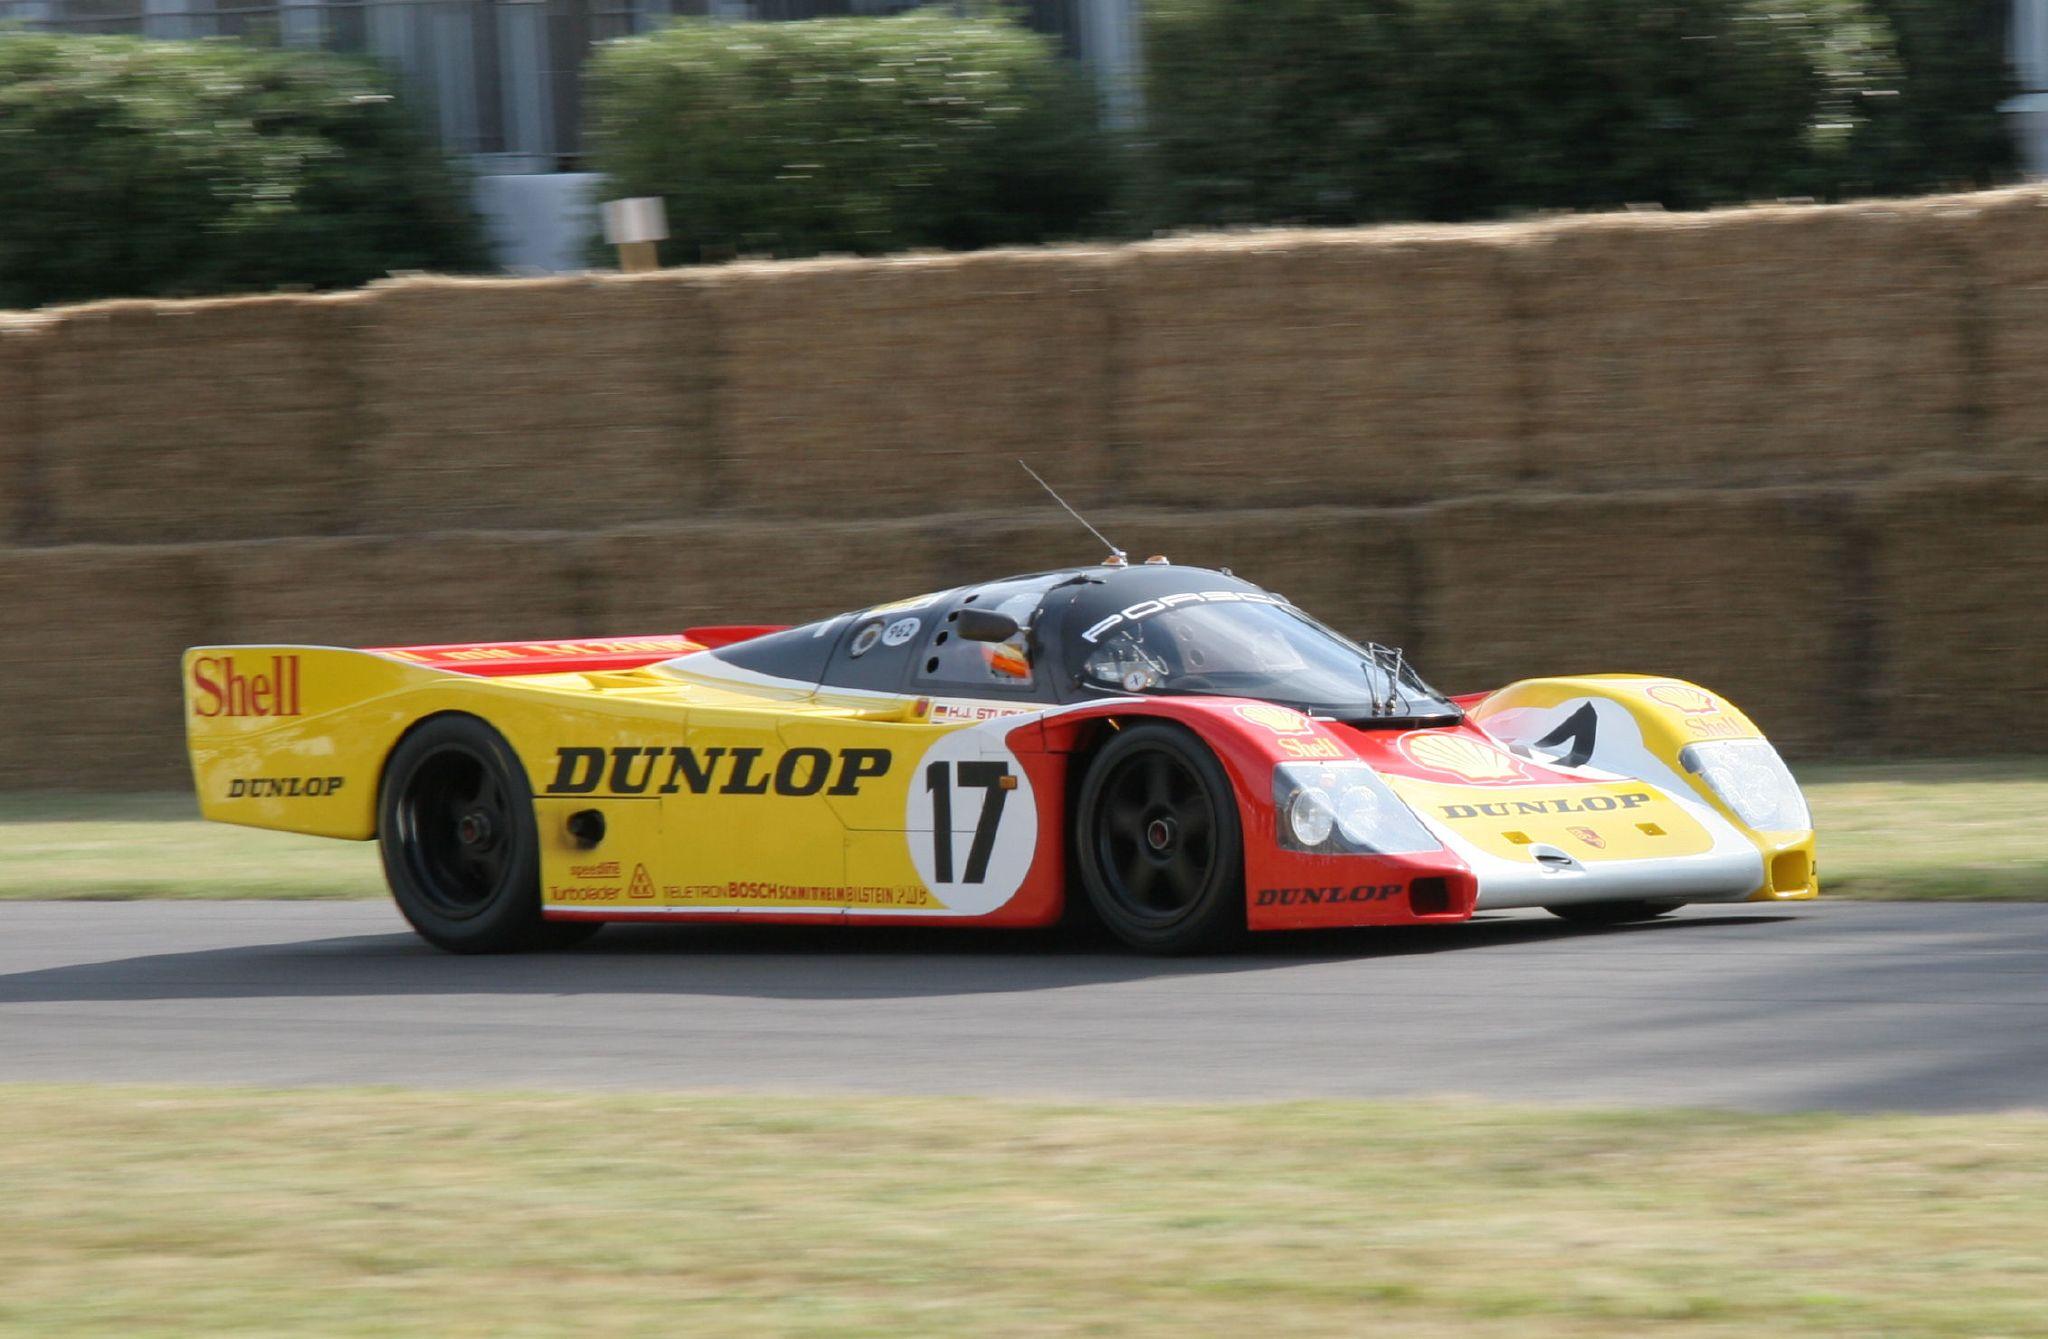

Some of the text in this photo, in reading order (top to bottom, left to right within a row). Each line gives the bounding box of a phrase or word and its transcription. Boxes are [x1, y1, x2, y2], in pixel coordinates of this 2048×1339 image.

[1082, 591, 1290, 643] PORSC
[889, 623, 915, 639] 962
[193, 655, 301, 717] Shell
[1684, 717, 1743, 738] Shell
[1277, 738, 1344, 757] Shell
[546, 746, 892, 796] DUNLOP
[227, 776, 344, 799] DUNLOP
[1438, 793, 1651, 819] DUNLOP
[926, 760, 1010, 884] 17
[728, 881, 777, 899] BOSCH
[847, 886, 893, 904] BILSTEIN
[1256, 884, 1403, 906] DUNLOP
